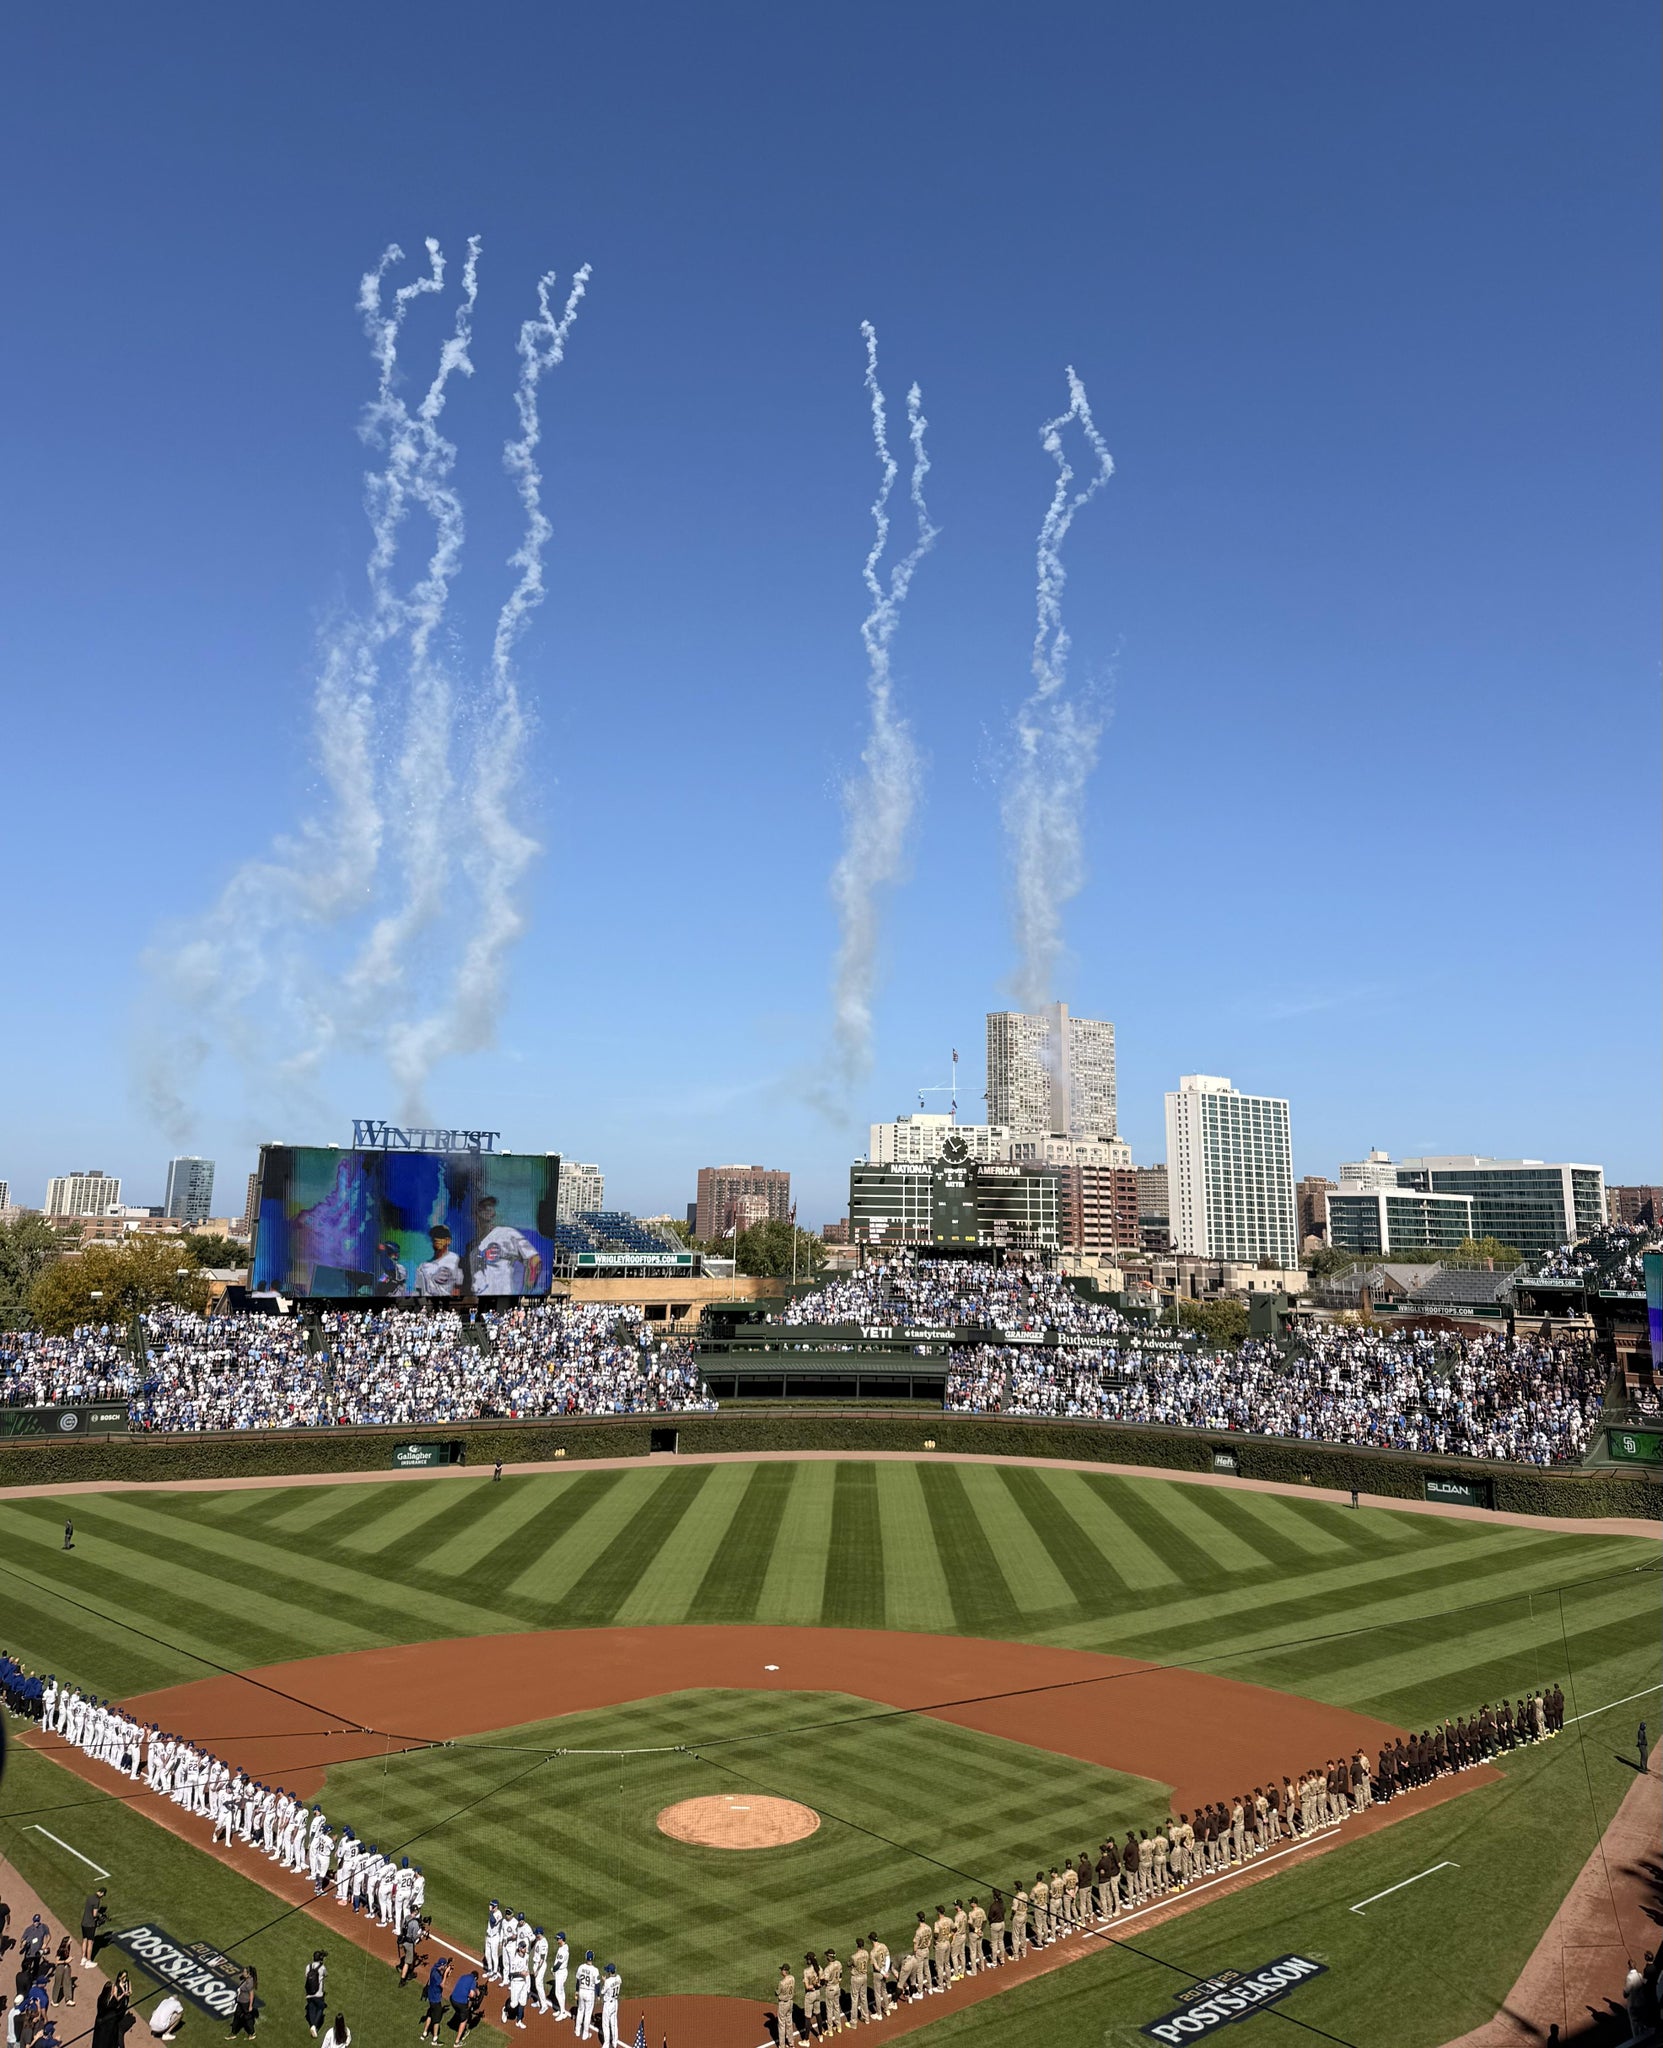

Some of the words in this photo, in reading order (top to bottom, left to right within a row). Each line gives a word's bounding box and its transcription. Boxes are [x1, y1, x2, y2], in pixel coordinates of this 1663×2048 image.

[352, 1119, 500, 1152] WINTRUST
[890, 1164, 933, 1174] NATIONAL
[977, 1166, 1021, 1176] AMERICAN
[860, 1327, 893, 1339] YETI
[911, 1330, 956, 1340] tastytrade
[1004, 1330, 1045, 1339] GRAINGER
[1142, 1338, 1183, 1350] Advocate
[397, 1452, 432, 1461] Gallagher
[1427, 1482, 1469, 1495] SLOAN
[188, 1763, 198, 1771] 22
[401, 1877, 412, 1888] 20
[580, 1974, 591, 1986] 29
[1151, 1956, 1319, 2043] POSTSEASON
